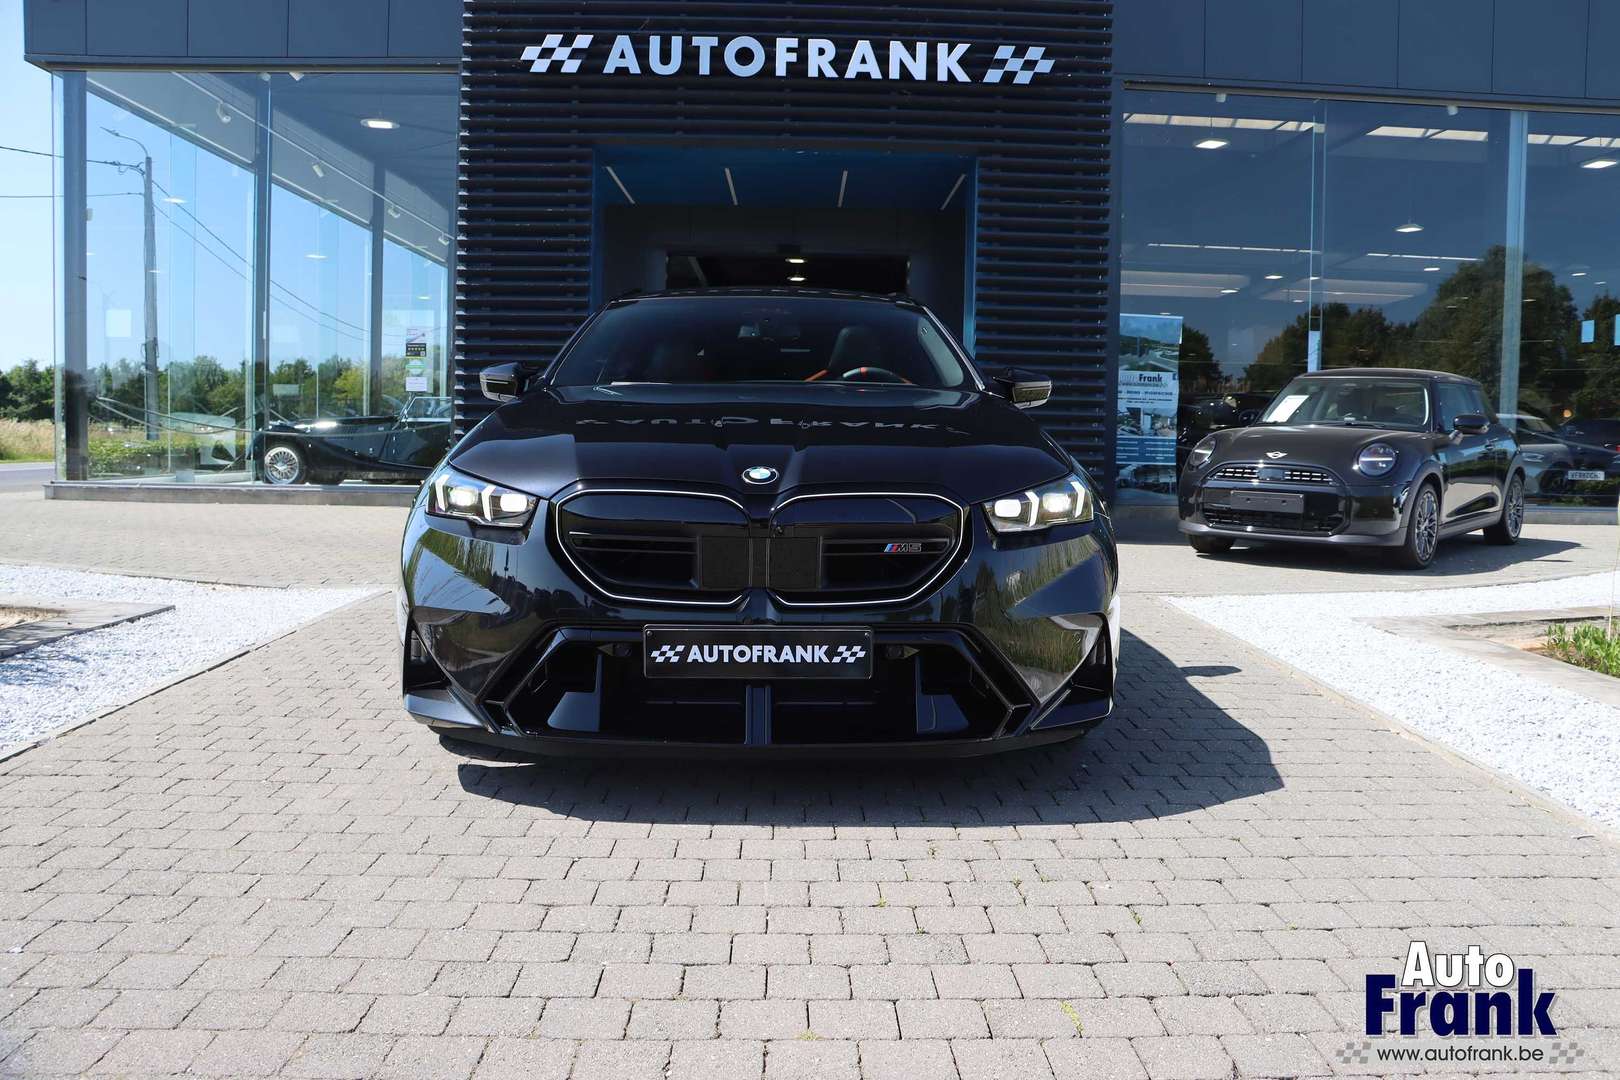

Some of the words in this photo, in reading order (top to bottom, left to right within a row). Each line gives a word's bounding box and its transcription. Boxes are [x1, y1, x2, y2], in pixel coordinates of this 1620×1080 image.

[602, 34, 972, 83] AUTOFRANK
[1139, 373, 1163, 382] Frank
[896, 543, 922, 553] M5
[686, 644, 830, 663] AUTOFRANK
